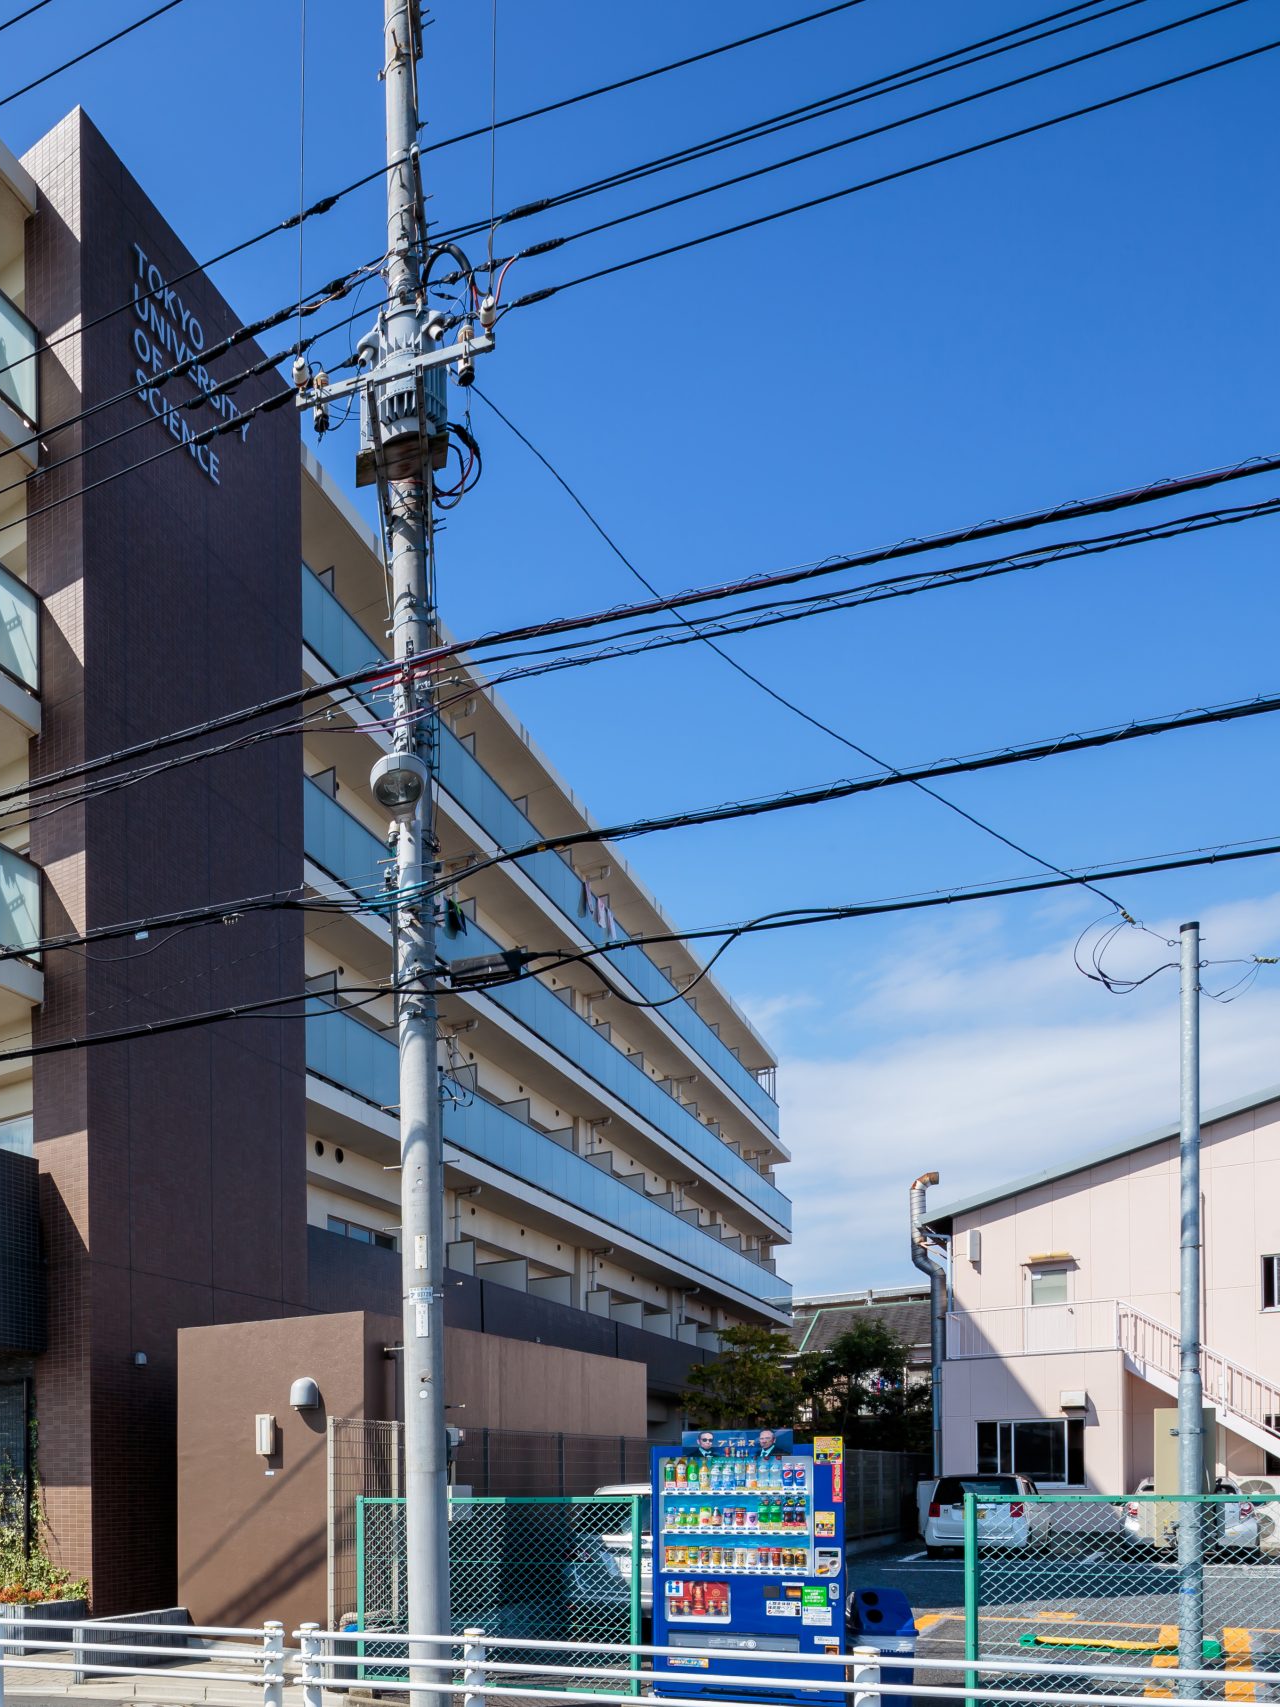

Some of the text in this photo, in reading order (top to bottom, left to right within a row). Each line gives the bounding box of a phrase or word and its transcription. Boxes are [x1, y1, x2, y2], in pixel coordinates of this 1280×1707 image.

[134, 242, 204, 350] TOKYO
[133, 328, 163, 374] OF
[135, 368, 220, 486] SCIENCE
